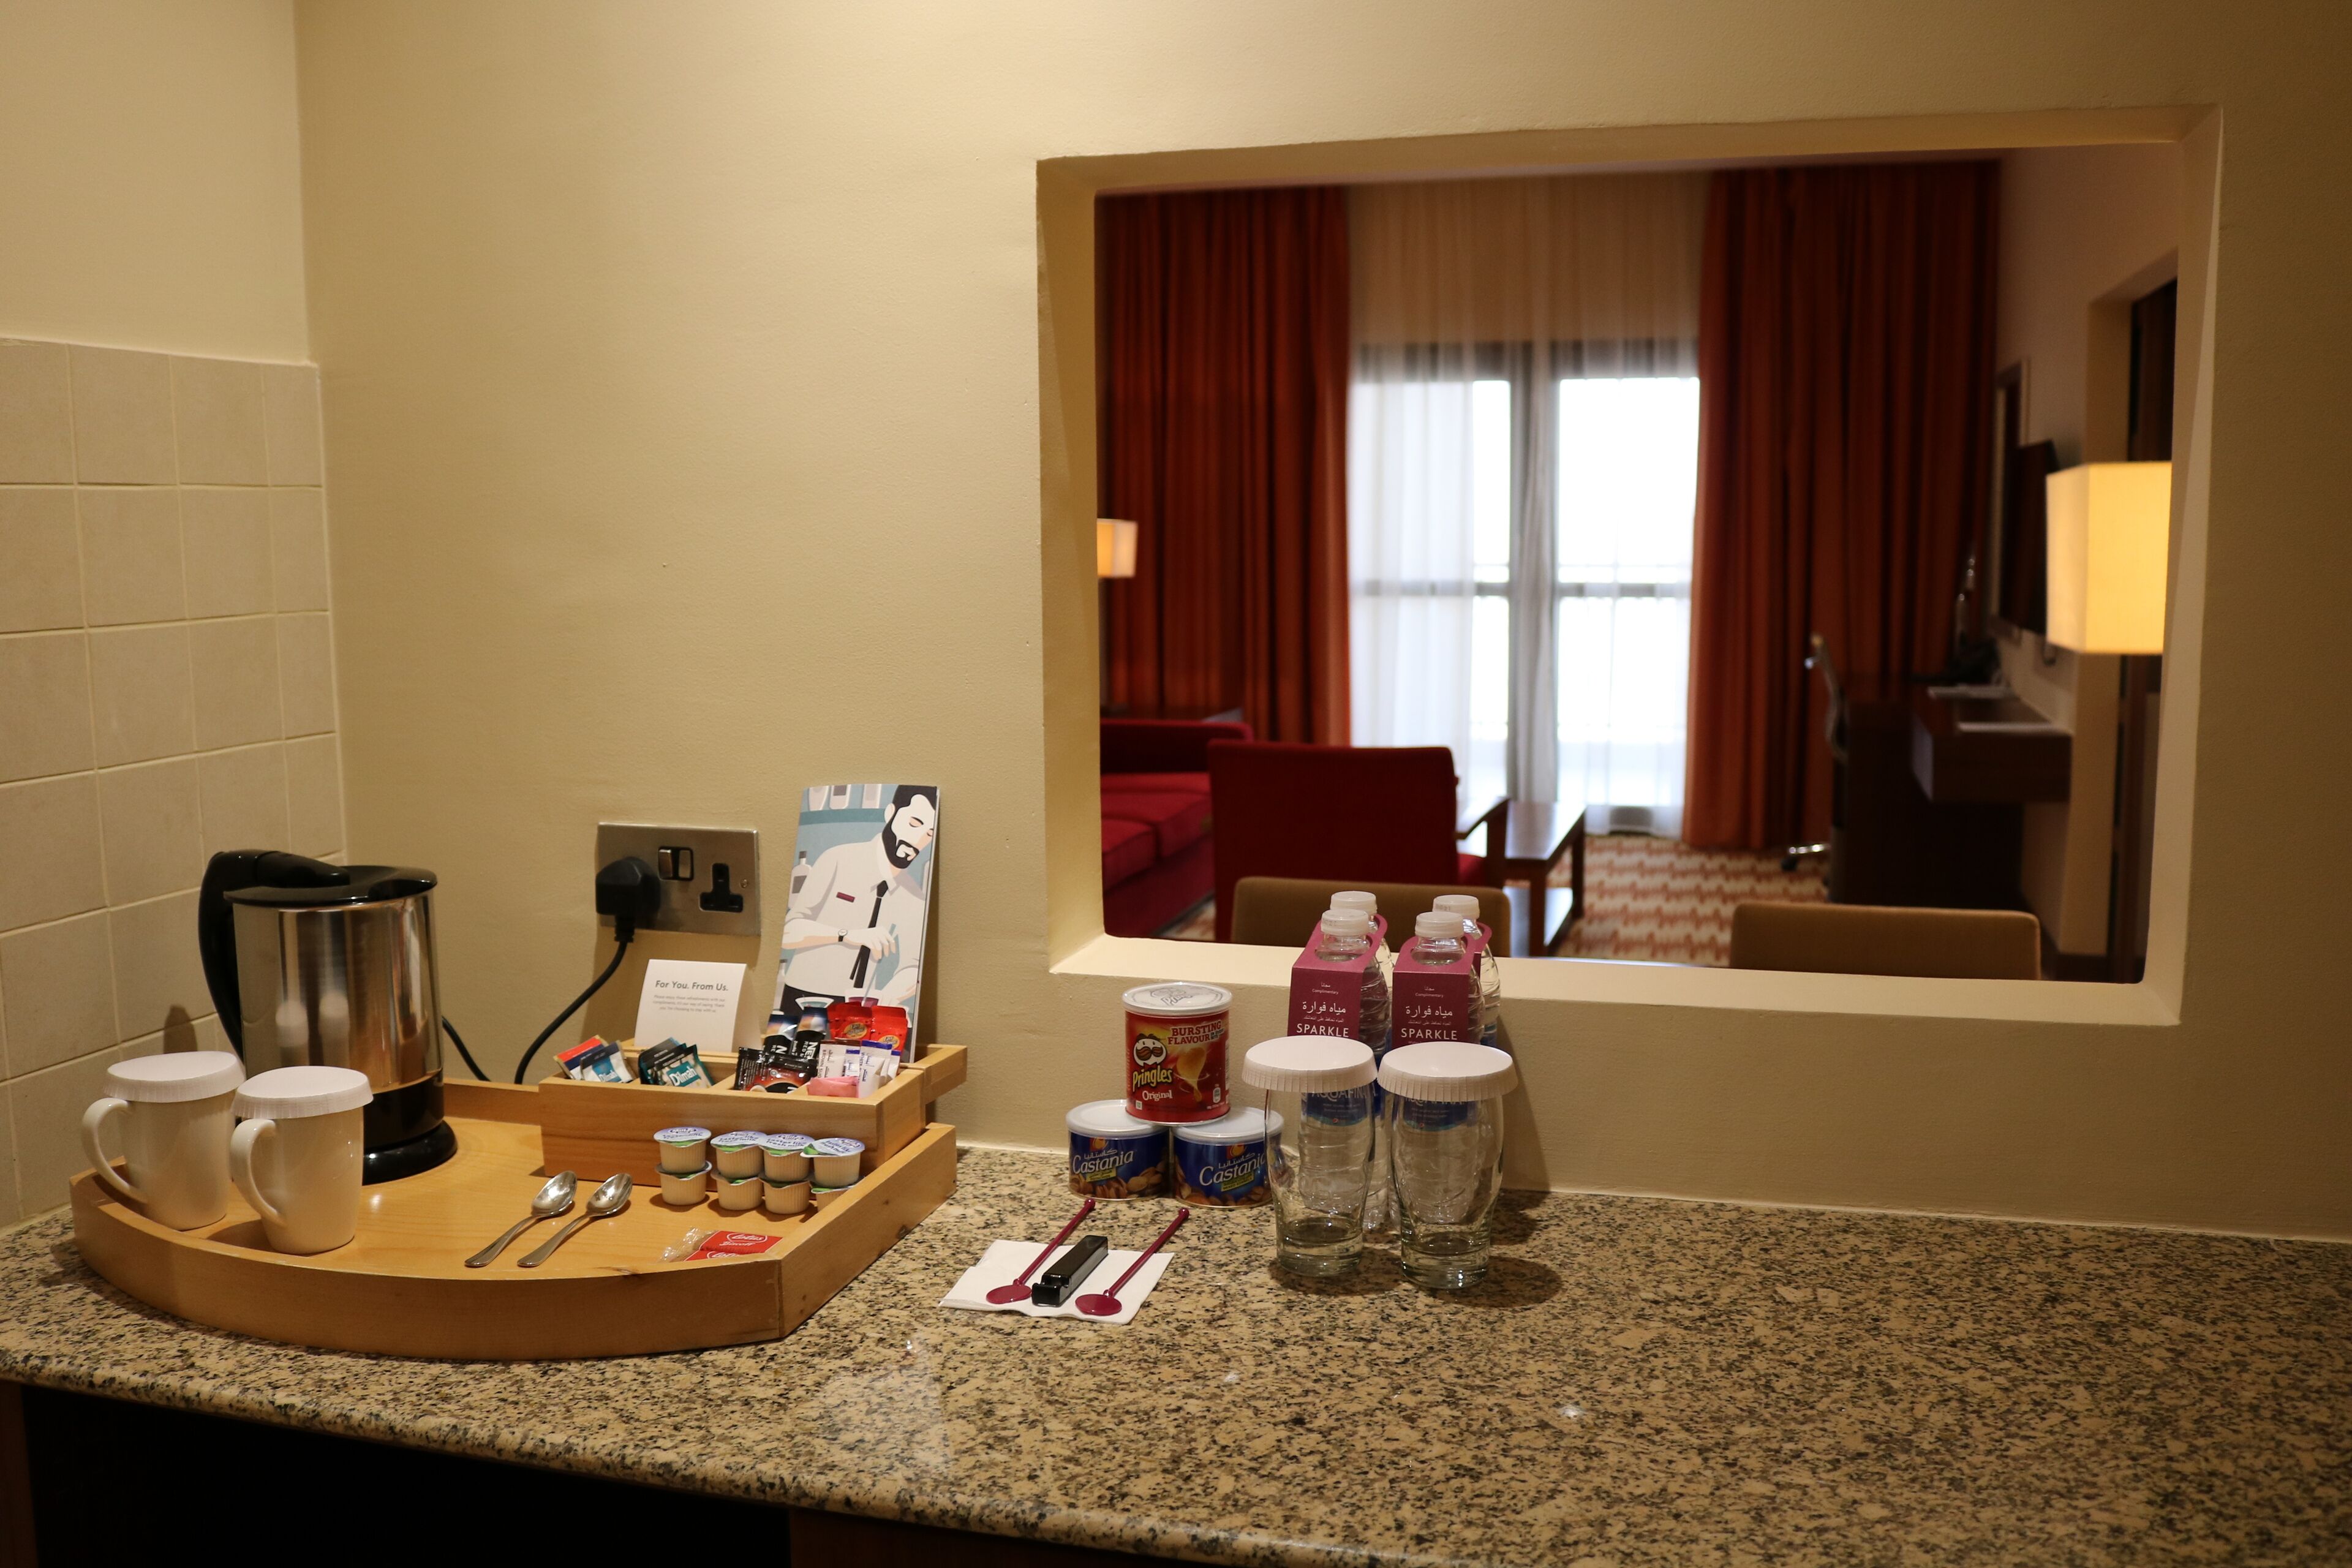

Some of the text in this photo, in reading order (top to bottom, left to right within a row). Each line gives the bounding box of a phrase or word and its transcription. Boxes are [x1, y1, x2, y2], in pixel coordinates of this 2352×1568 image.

[692, 982, 714, 990] From
[1302, 1001, 1346, 1016] مياه فوارة
[1406, 1005, 1453, 1019] مياه فوارة
[1172, 1021, 1221, 1036] BURSTING
[1296, 1023, 1349, 1038] SPARKLE
[1401, 1028, 1458, 1040] SPARKLE
[1167, 1033, 1210, 1045] FLAVOUR
[669, 1066, 697, 1087] Dilmah
[1133, 1065, 1172, 1092] Pringles
[1142, 1090, 1173, 1101] Original
[1084, 1148, 1117, 1159] كاستانيا
[1072, 1150, 1134, 1174] Castania
